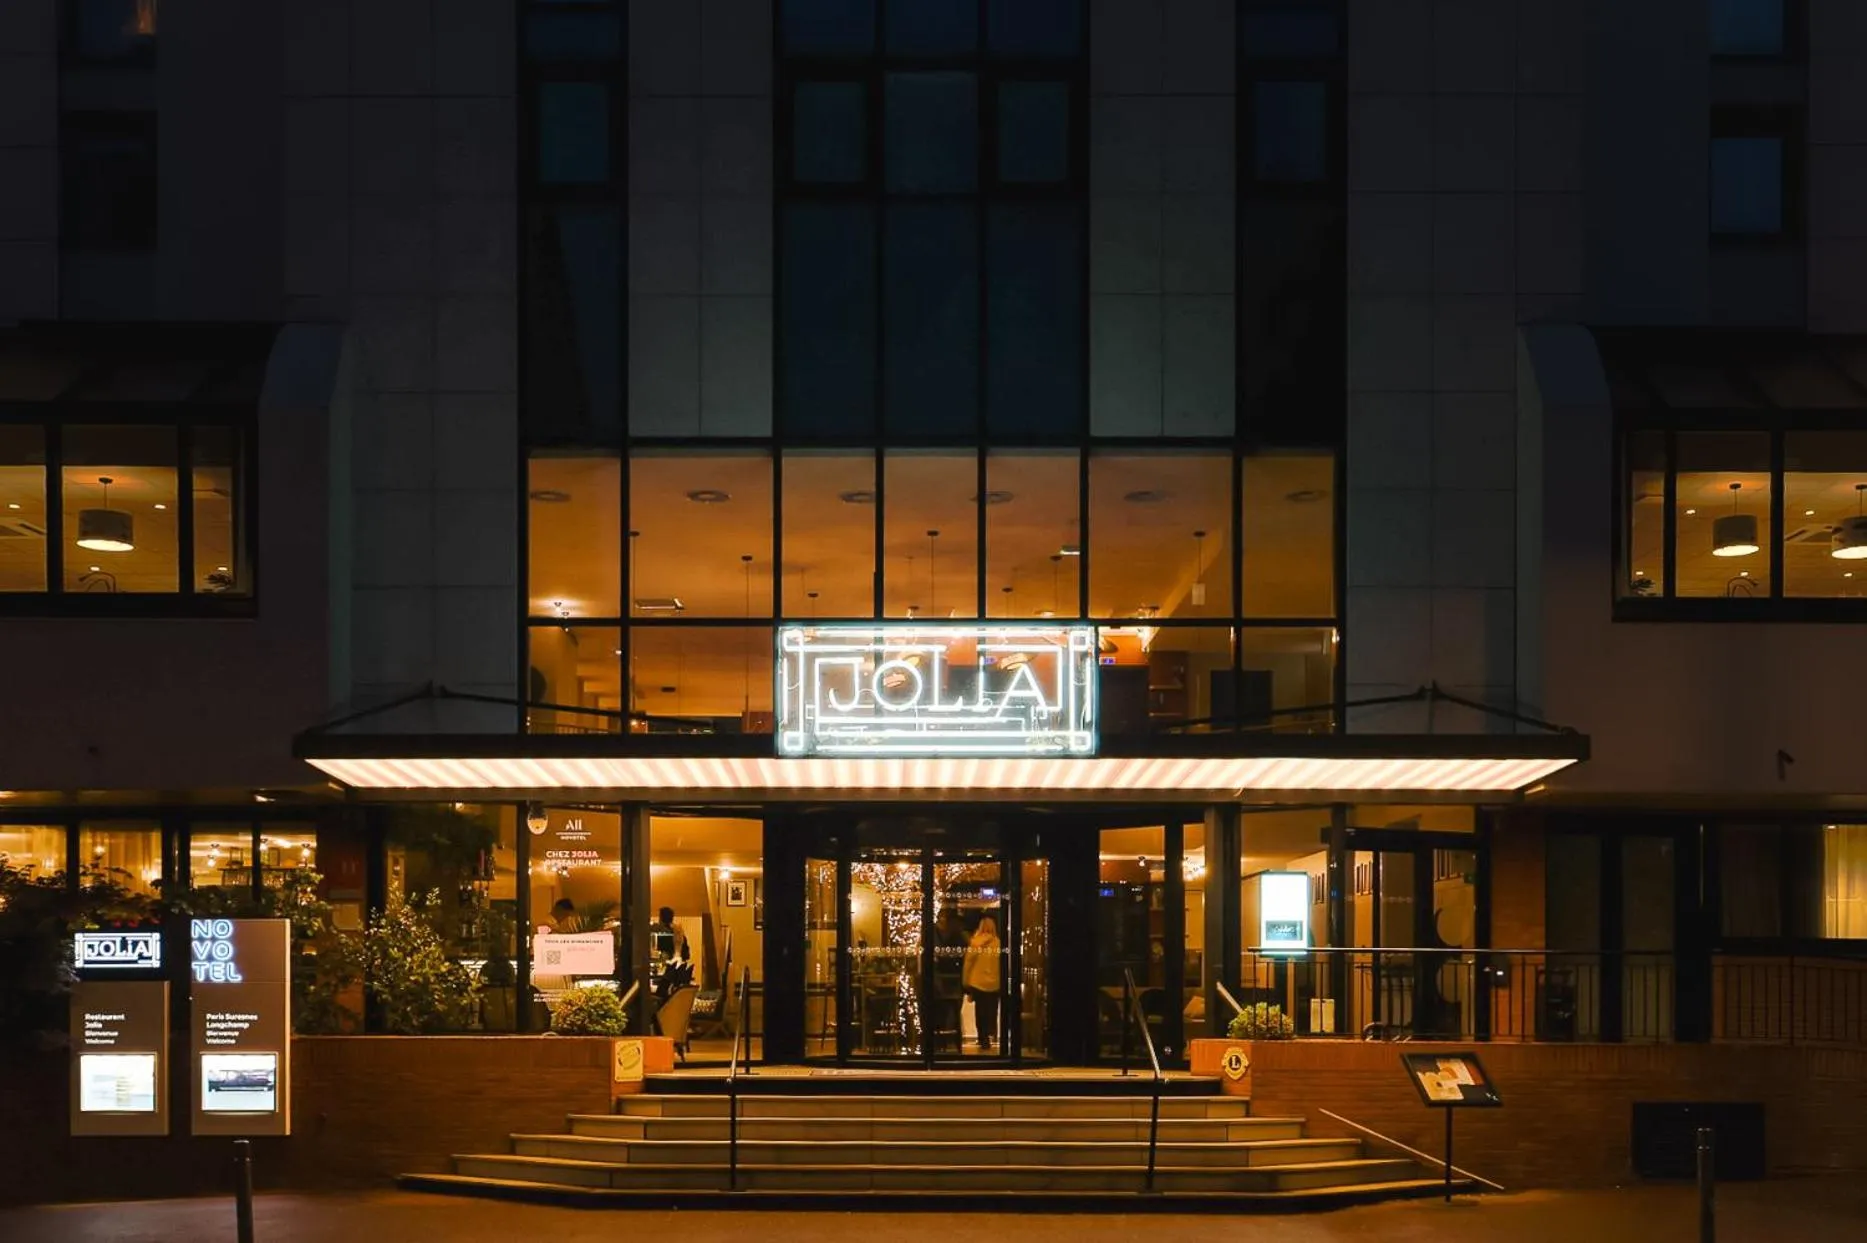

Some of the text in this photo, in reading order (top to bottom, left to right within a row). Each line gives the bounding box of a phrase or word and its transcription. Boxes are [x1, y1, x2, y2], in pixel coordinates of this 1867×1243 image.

[827, 647, 1048, 717] JOLIA
[545, 850, 599, 858] CHEZ JOLIA
[543, 859, 602, 867] RESTAURANT
[206, 1021, 250, 1029] Longchamp
[1231, 1055, 1240, 1069] L
